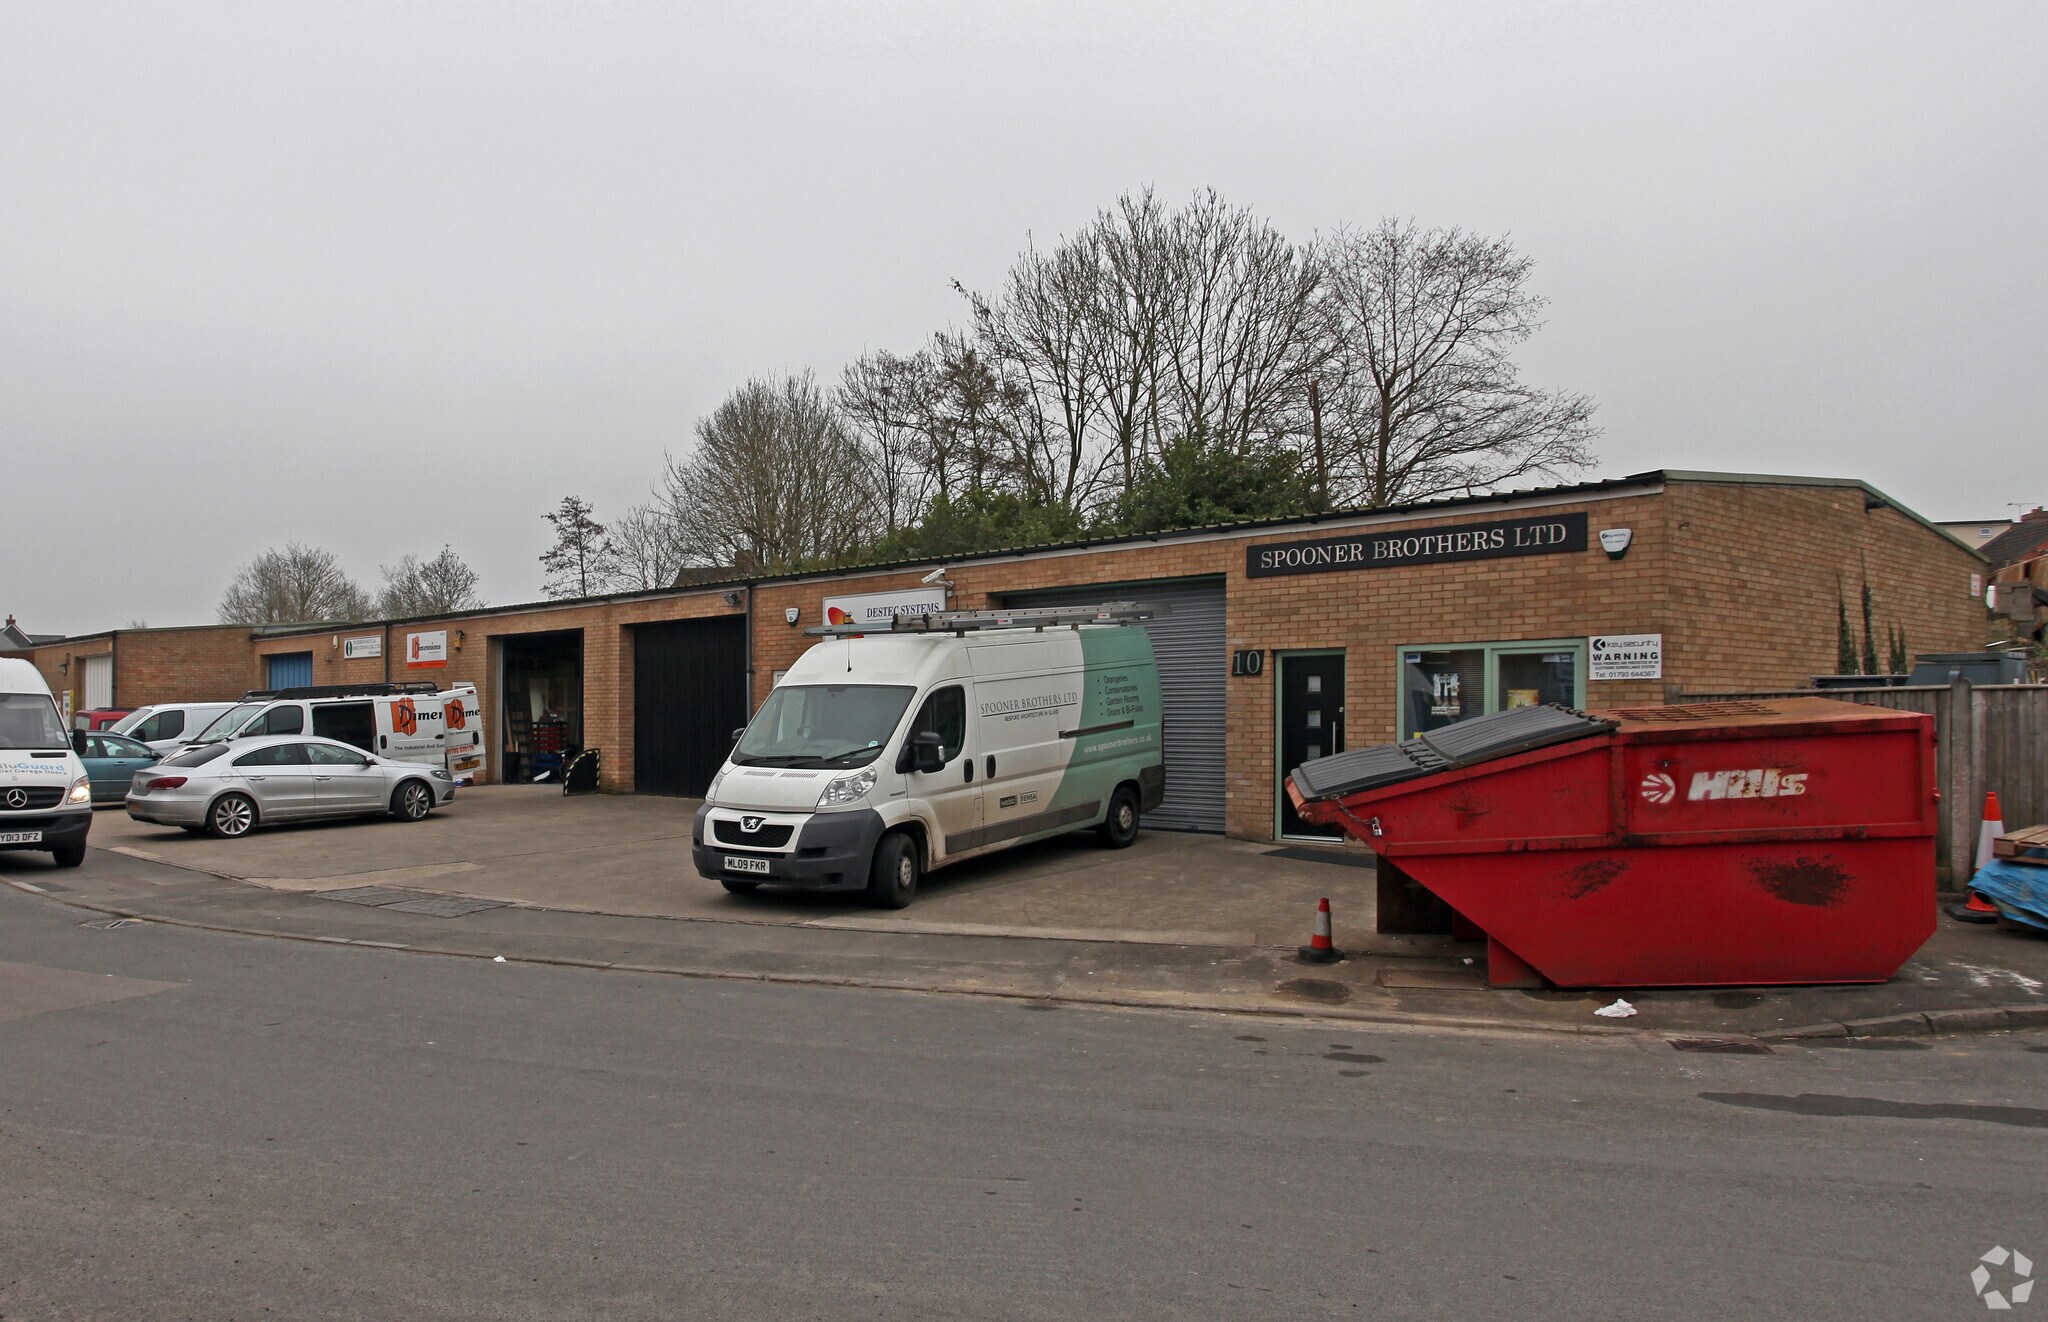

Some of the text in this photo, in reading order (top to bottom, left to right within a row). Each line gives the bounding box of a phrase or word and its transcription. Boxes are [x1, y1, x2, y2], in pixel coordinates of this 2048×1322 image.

[1261, 523, 1567, 569] SPOONER BROTHERS LTD
[866, 602, 940, 618] DESTEC SYSTEMS
[1623, 640, 1659, 648] security
[1232, 651, 1261, 674] 10
[1592, 652, 1659, 661] WARNING
[1103, 675, 1129, 685] Orangeries
[1104, 684, 1138, 695] Conservatories
[980, 691, 1078, 714] SPOONER BROTHERS LTD
[1106, 695, 1140, 706] Garden Rooms
[1106, 708, 1121, 717] Doors
[1126, 704, 1145, 714] Bi-Folds
[1083, 733, 1153, 754] www.spoonerbrothers.co.uk
[1687, 768, 1809, 801] Hills
[1020, 793, 1037, 803] FENSA
[0, 832, 39, 842] YD13 DFZ
[727, 858, 766, 871] ML09 FKR
